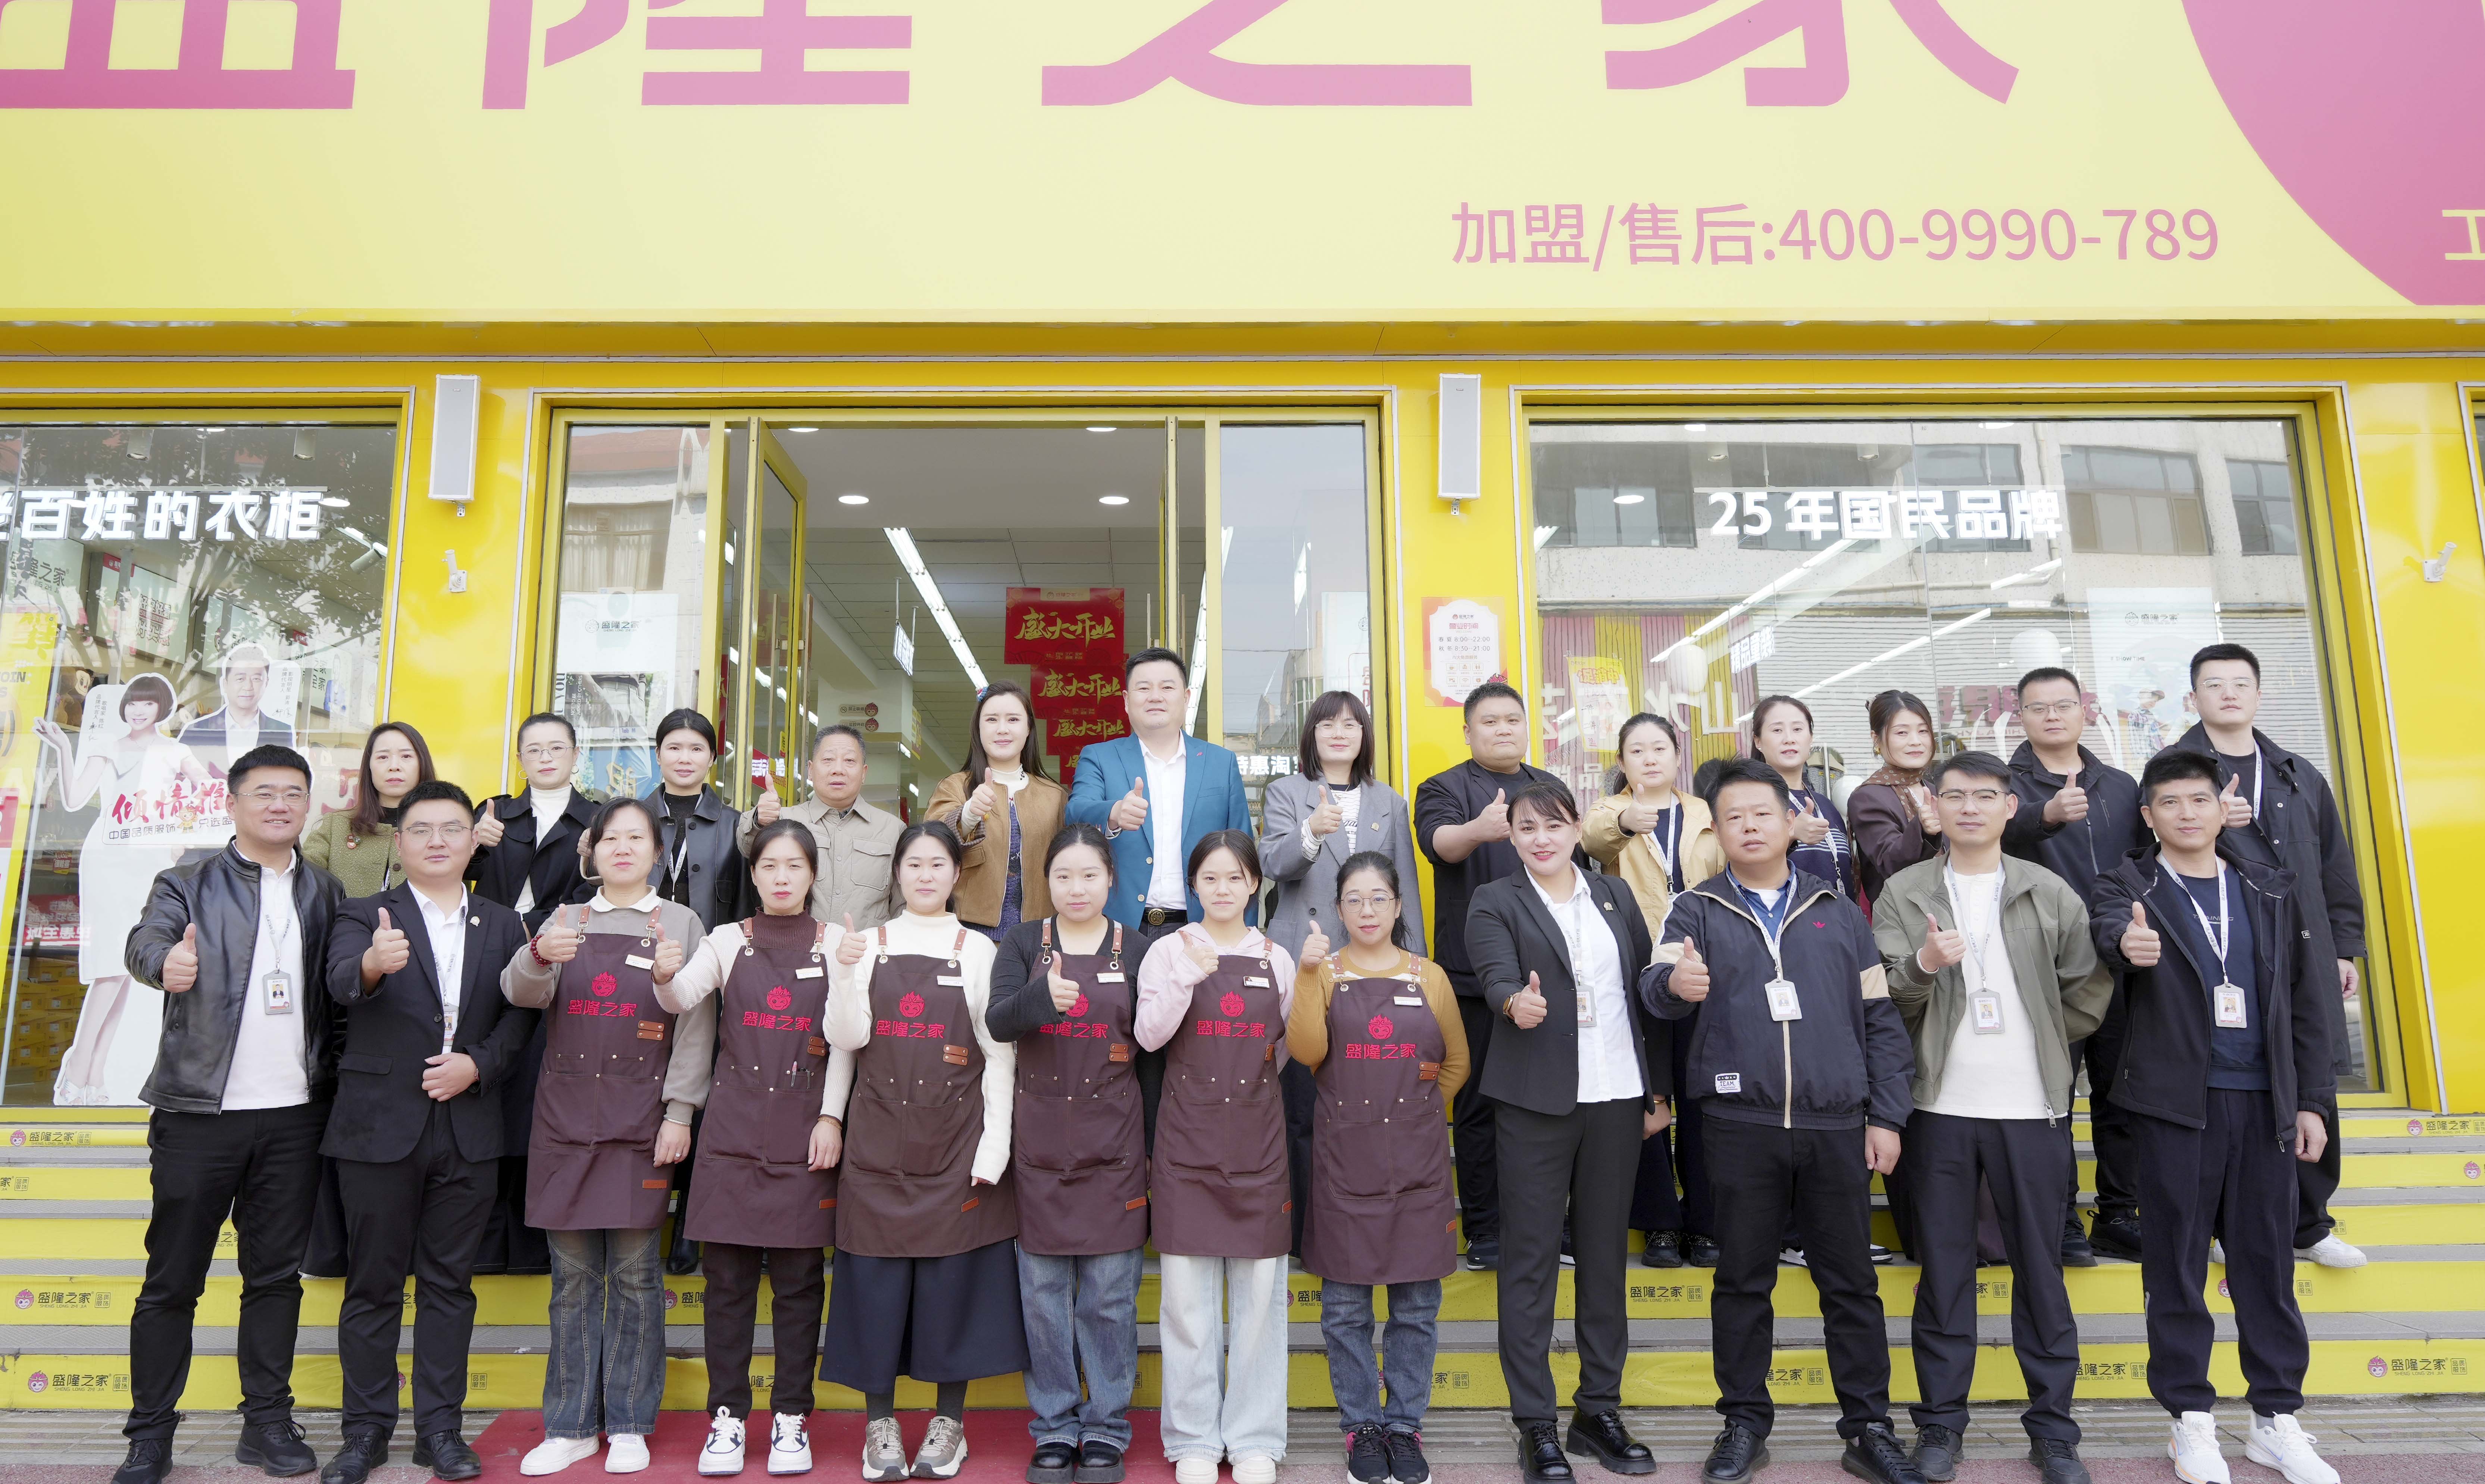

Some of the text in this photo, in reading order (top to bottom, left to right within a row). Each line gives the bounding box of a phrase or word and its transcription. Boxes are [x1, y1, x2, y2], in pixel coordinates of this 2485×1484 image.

[1452, 202, 2218, 271] 加盟/售后:400-9990-789
[0, 491, 323, 541] 百姓的衣柜
[1014, 606, 1116, 647] 盛大开业
[1037, 668, 1122, 705] 盛大开业
[1053, 719, 1125, 741] 盛大开业
[1237, 755, 1298, 775] 特惠淘
[109, 823, 175, 840] 中国品质服饰
[568, 999, 637, 1016] 盛隆之家
[742, 1011, 812, 1032] 盛隆之家
[876, 1020, 945, 1039] 盛隆之家
[1196, 1020, 1266, 1038] 盛隆之家
[1345, 1043, 1416, 1060] 盛隆之家
[2426, 1121, 2470, 1131] 盛隆之家
[29, 1132, 74, 1141] 盛隆之家
[38, 1292, 91, 1303] 盛隆之家
[1630, 1286, 1682, 1298] 盛隆之家
[2391, 1359, 2446, 1371] 盛隆之家
[52, 1374, 108, 1386] 盛隆之家
